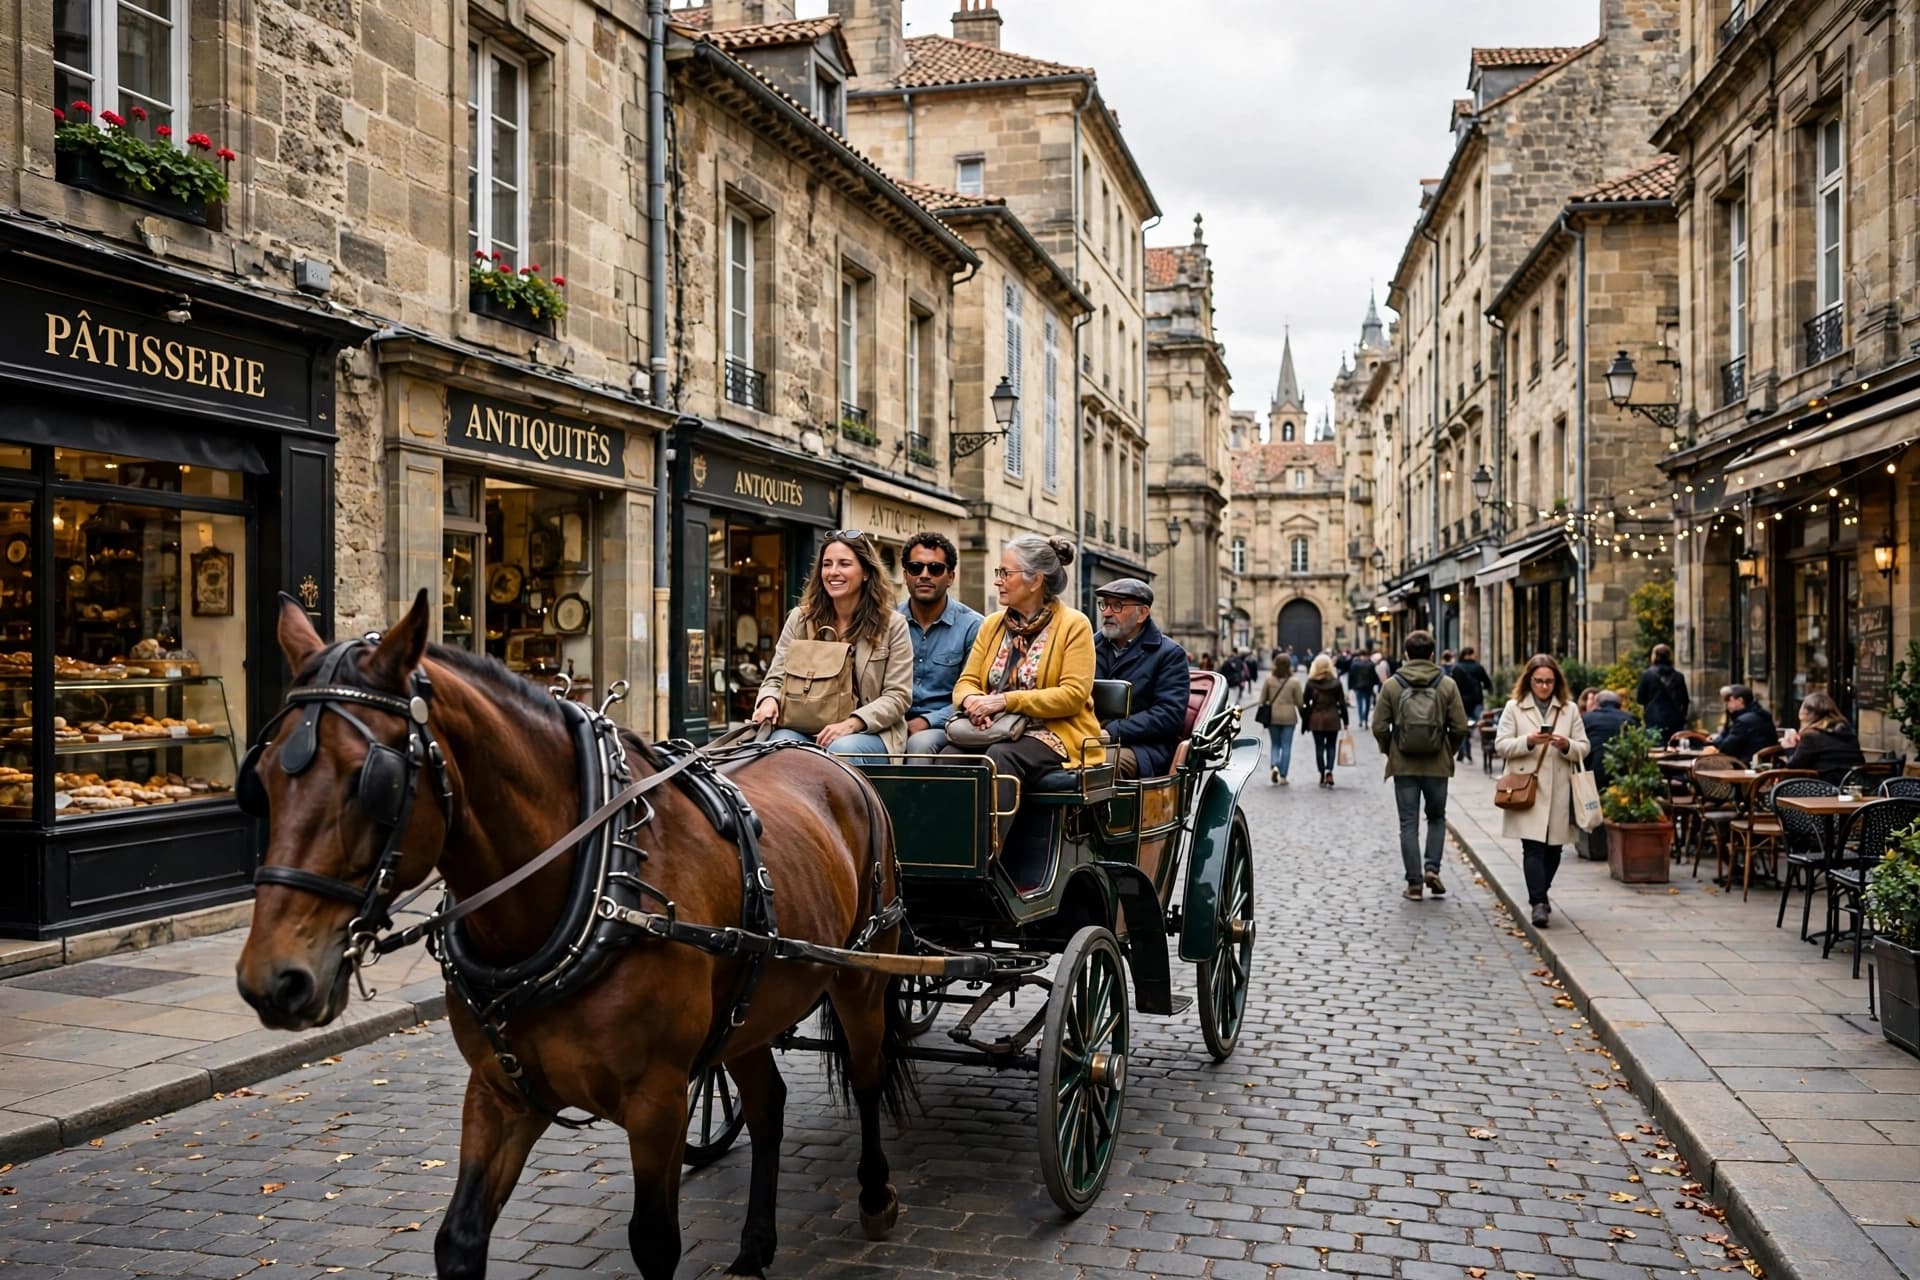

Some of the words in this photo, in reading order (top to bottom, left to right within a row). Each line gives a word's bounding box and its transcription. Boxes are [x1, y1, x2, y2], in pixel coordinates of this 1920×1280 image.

[45, 309, 265, 398] PÂTISSERIE
[465, 403, 611, 467] ANTIQUITÉS
[734, 471, 803, 506] ANTIQUITÉS
